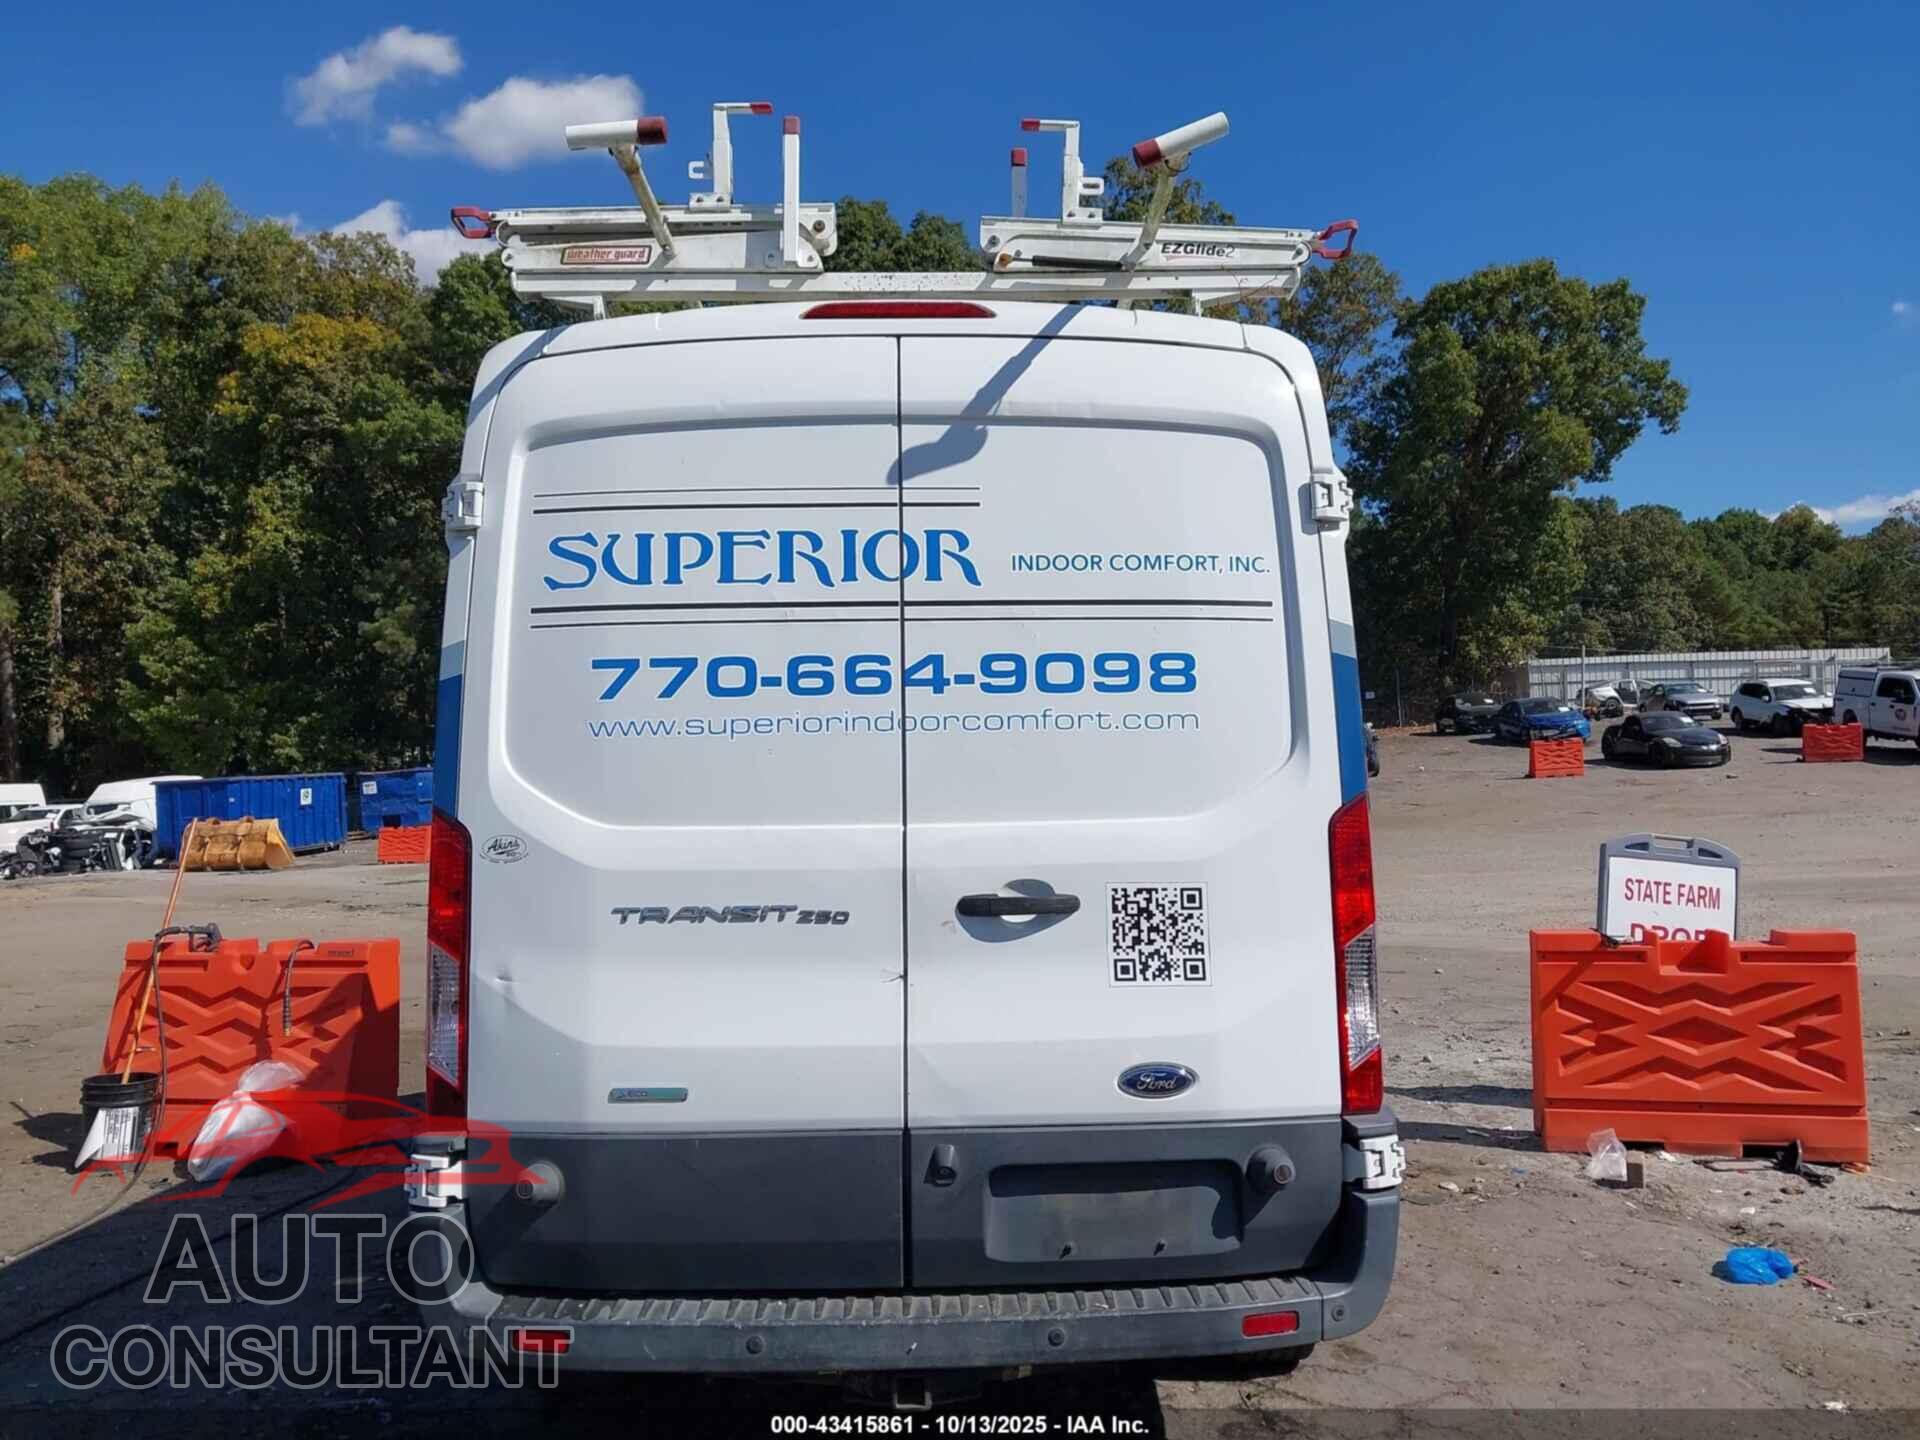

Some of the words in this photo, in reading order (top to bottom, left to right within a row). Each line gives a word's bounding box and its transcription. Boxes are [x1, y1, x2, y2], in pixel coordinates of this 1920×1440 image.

[614, 247, 646, 262] guard
[1161, 242, 1235, 257] EZGlide2
[543, 527, 982, 590] SUPERIOR
[1011, 554, 1102, 572] INDOOR
[1109, 554, 1223, 574] COMFORT,
[1229, 556, 1270, 573] INC.
[591, 652, 1197, 701] 770-664-9098
[589, 708, 1200, 739] www.superiorindoorcomfort.com
[1624, 878, 1672, 905] STATE
[1677, 883, 1721, 910] FARM
[611, 904, 798, 925] TRANSIT
[1136, 1070, 1178, 1089] Ford
